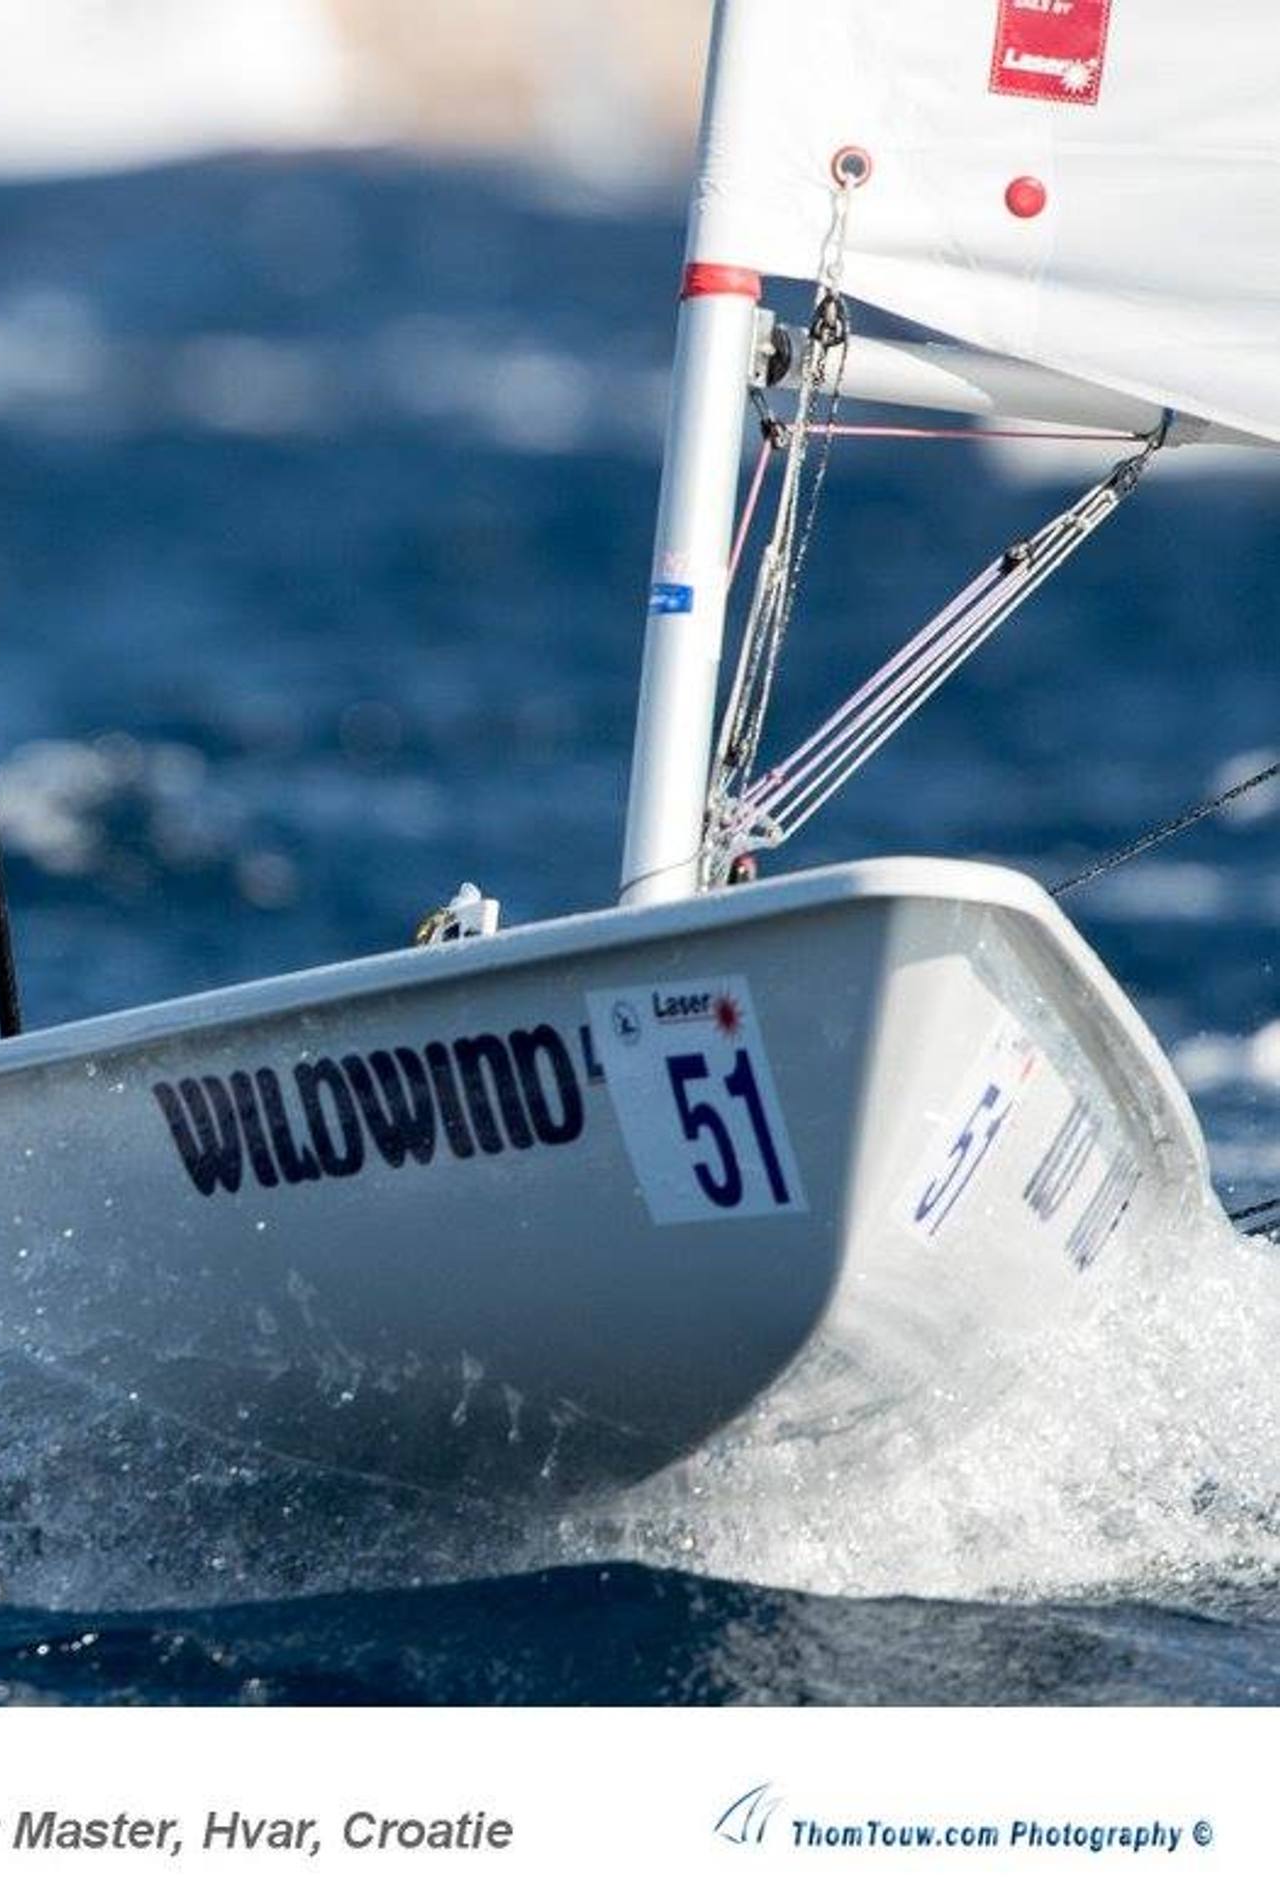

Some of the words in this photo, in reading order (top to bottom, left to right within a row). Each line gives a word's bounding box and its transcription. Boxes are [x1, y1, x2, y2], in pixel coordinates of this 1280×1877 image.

[652, 991, 712, 1018] Laser
[151, 1023, 585, 1198] WILDWIND
[666, 1048, 791, 1209] 51
